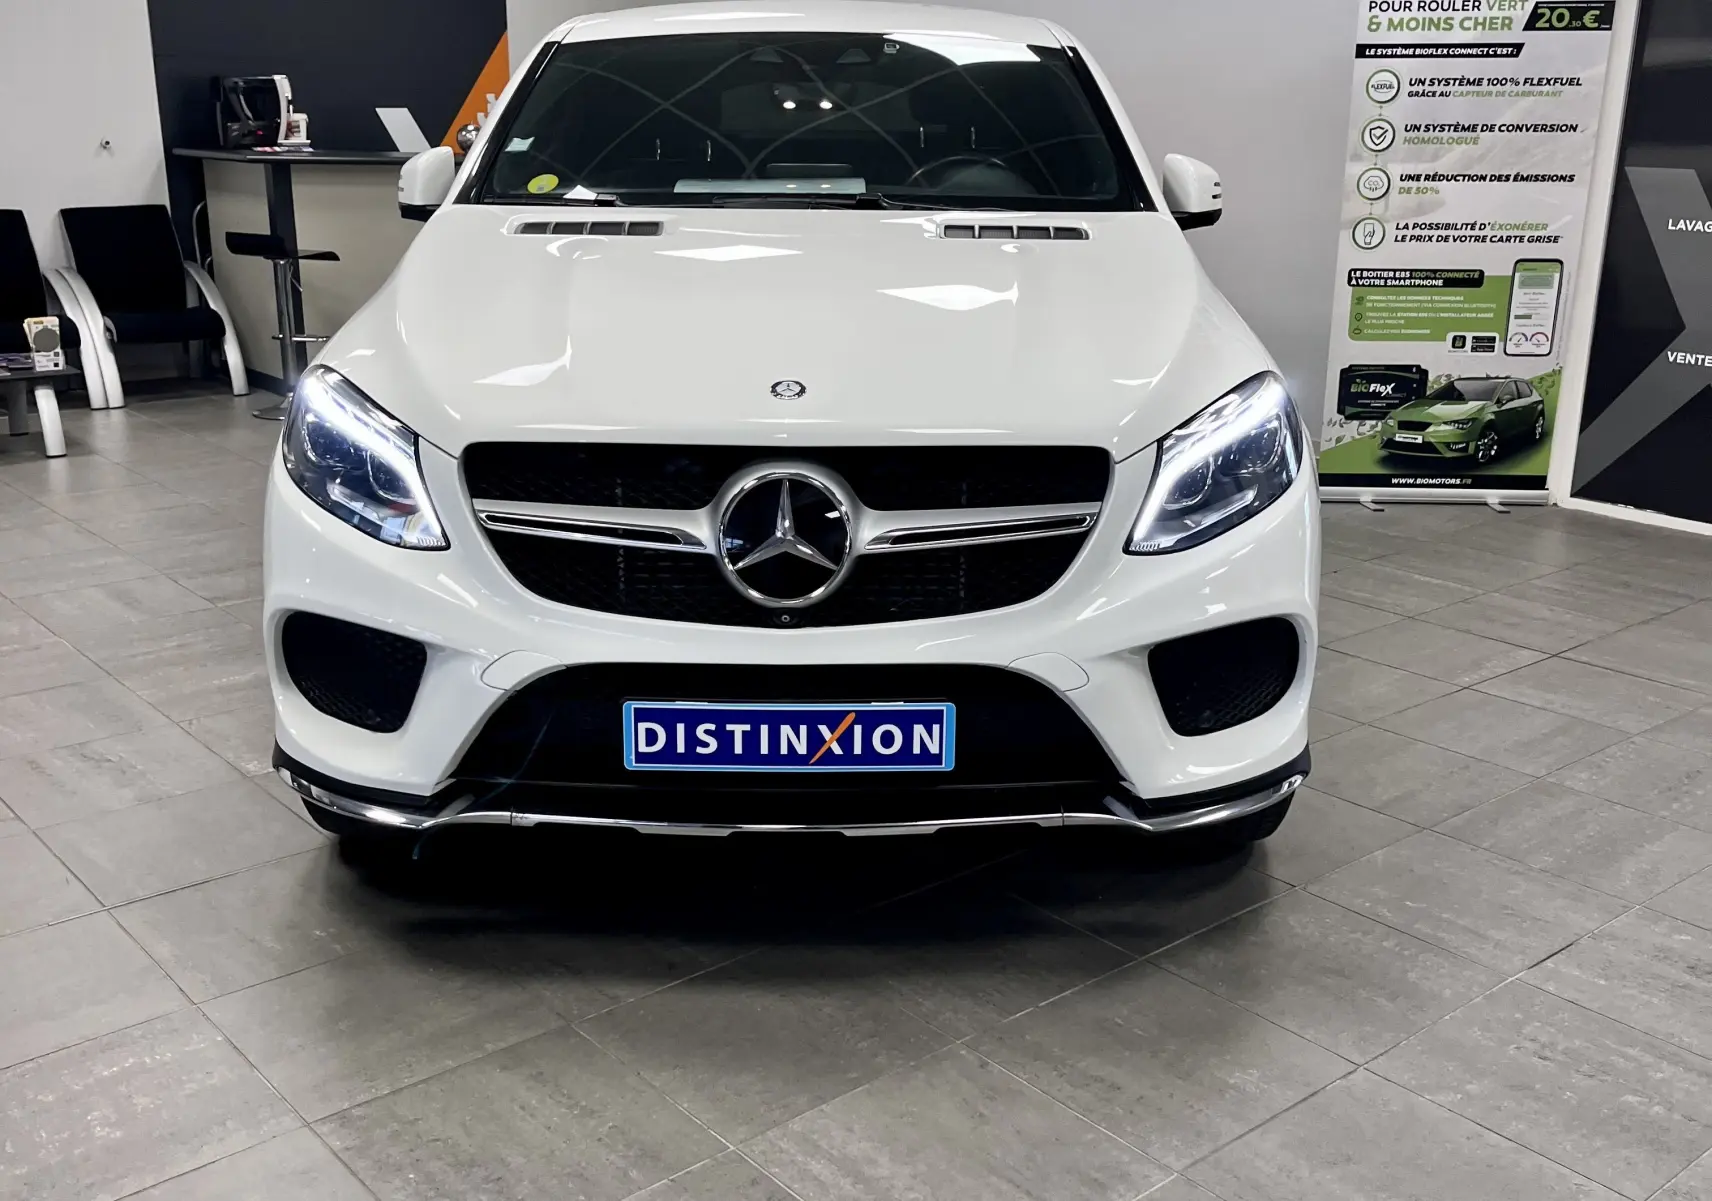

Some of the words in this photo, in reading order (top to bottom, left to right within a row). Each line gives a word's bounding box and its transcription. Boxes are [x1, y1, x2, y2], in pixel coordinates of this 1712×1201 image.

[1368, 0, 1413, 12] POUR
[1417, 0, 1482, 12] ROULER
[1486, 0, 1529, 11] VERT
[1367, 15, 1382, 32] &
[1387, 16, 1455, 32] MOINS
[1459, 16, 1514, 31] CHER
[1377, 46, 1414, 55] SYSTÈME
[1408, 77, 1427, 87] UN
[1427, 75, 1485, 87] SYSTÈME
[1486, 77, 1520, 87] 100%
[1522, 77, 1583, 87] FLEXFUEL
[1438, 90, 1452, 98] AU
[1452, 90, 1494, 98] CAPTEUR
[1494, 90, 1507, 98] DE
[1507, 90, 1564, 98] CARBURANT
[1404, 124, 1422, 133] UN
[1423, 121, 1480, 133] SYSTÈME
[1480, 124, 1497, 133] DE
[1497, 123, 1579, 133] CONVERSION
[1399, 173, 1423, 182] UNE
[1423, 171, 1488, 182] RÉDUCTION
[1488, 173, 1512, 183] DES
[1512, 171, 1576, 183] ÉMISSIONS
[1398, 186, 1413, 195] DE
[1414, 186, 1440, 195] 50%
[1395, 222, 1410, 231] LA
[1411, 220, 1478, 231] POSSIBILITÉ
[1394, 234, 1408, 243] LE
[1408, 234, 1435, 243] PRIX
[1435, 234, 1451, 243] DE
[1452, 234, 1489, 243] VOTRE
[1489, 234, 1526, 243] CARTE
[1362, 270, 1394, 278] BOITIER
[1435, 270, 1480, 278] CONNECTÉ
[1358, 278, 1386, 286] VOTRE
[1386, 278, 1444, 286] SMARTPHONE
[1667, 350, 1712, 367] VENTE
[636, 712, 941, 765] DISTINXION
